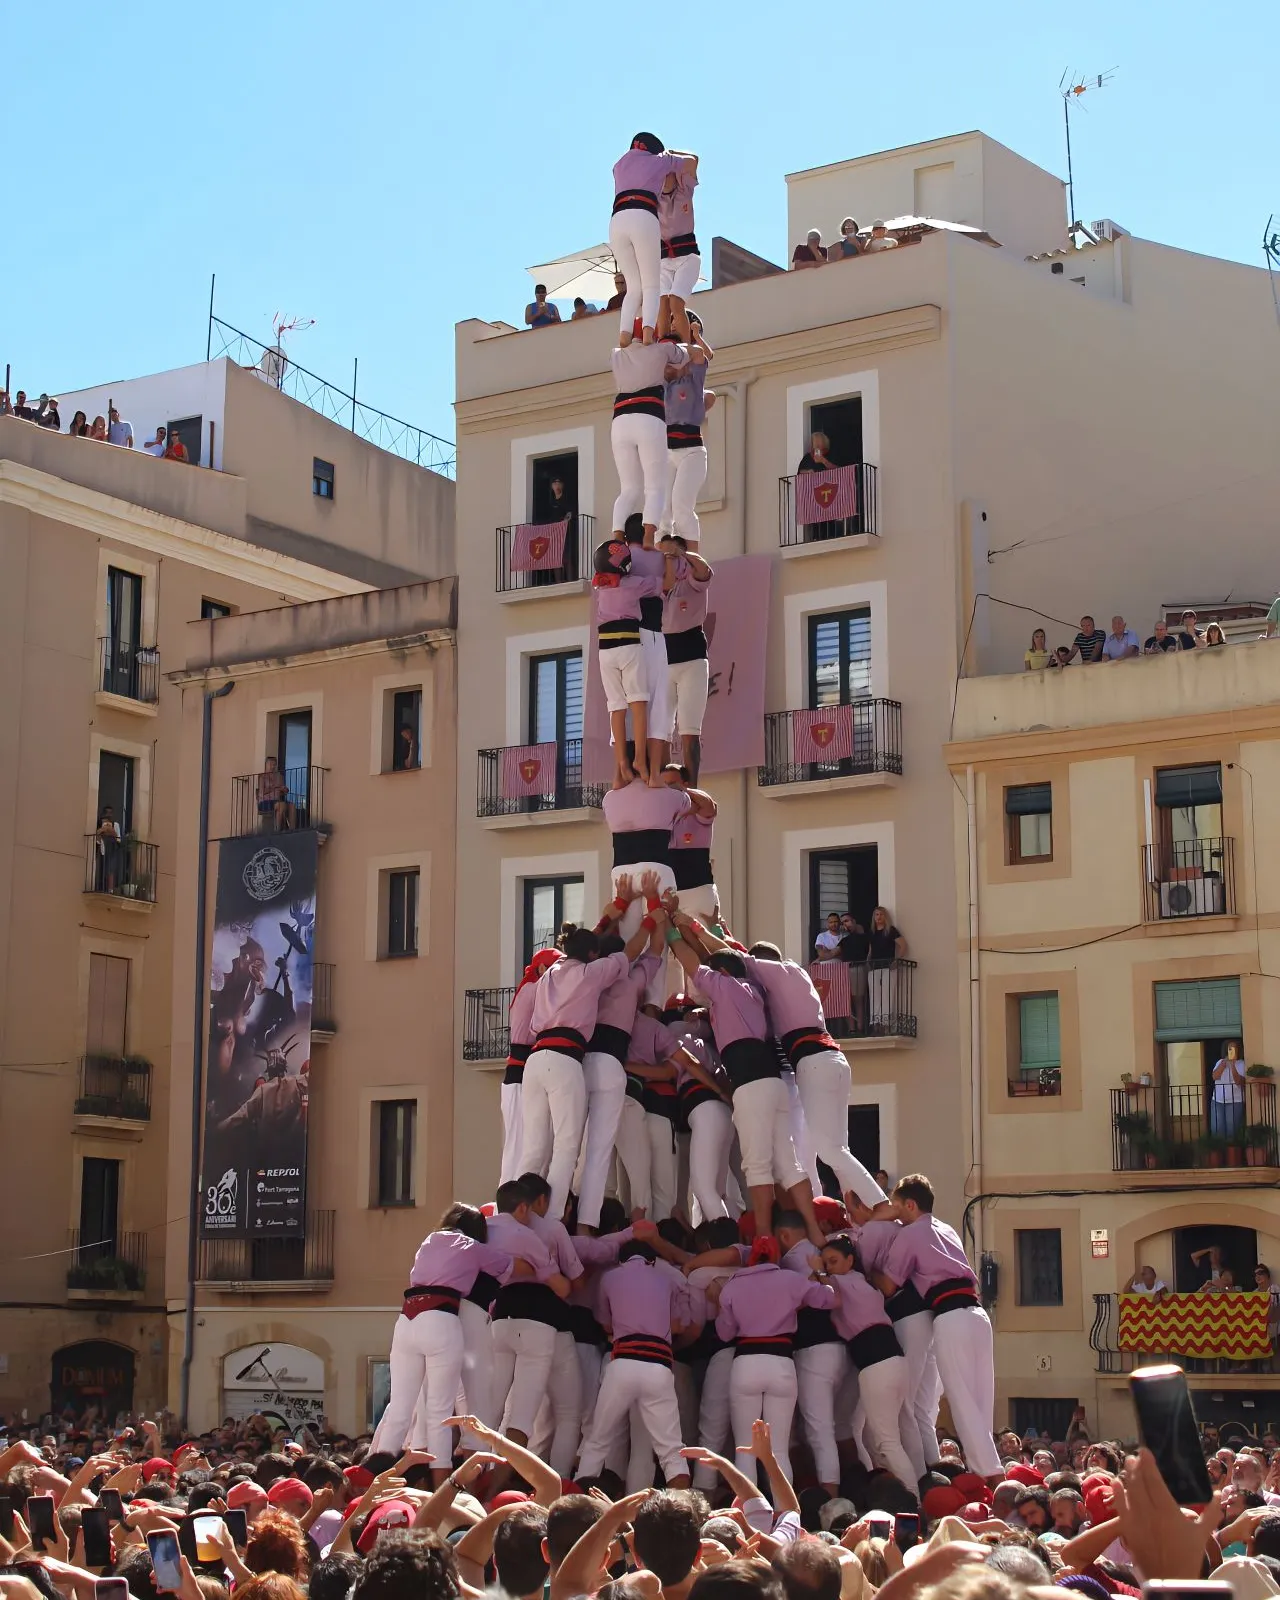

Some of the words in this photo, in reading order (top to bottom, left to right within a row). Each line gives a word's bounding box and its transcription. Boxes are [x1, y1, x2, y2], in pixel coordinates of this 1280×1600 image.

[821, 489, 832, 503] T
[818, 728, 828, 743] T
[524, 765, 534, 778] T
[266, 1168, 300, 1176] REPSOL
